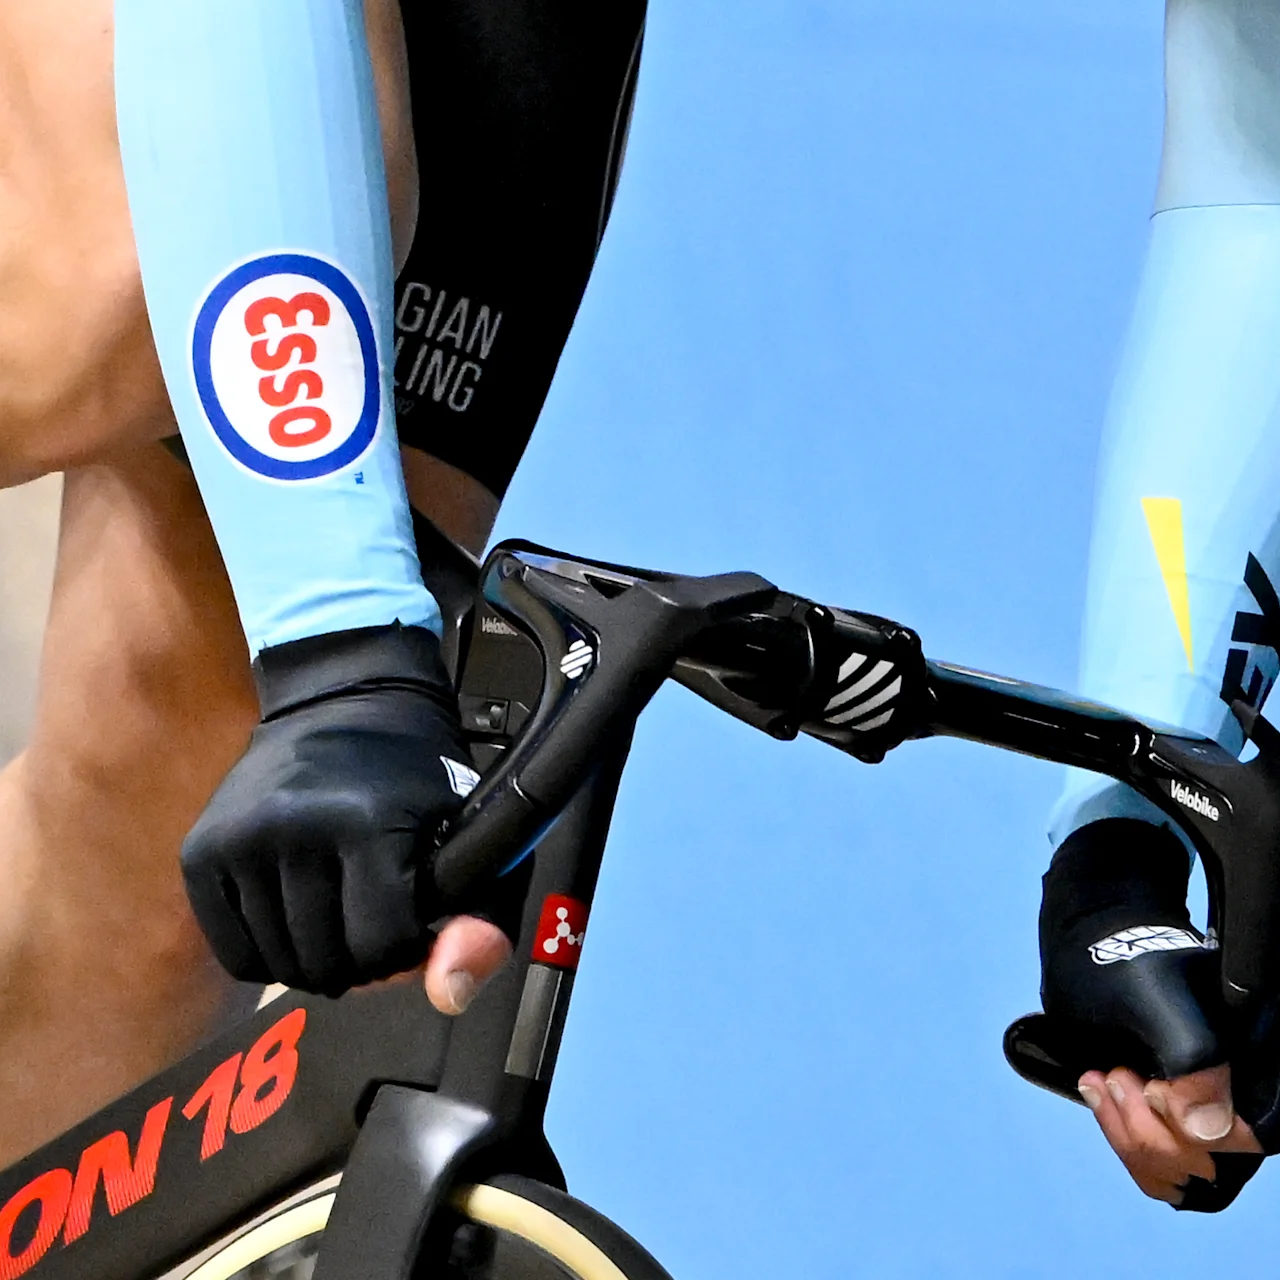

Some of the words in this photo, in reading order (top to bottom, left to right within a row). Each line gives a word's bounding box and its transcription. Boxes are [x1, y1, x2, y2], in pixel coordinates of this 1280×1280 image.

[243, 291, 332, 448] Esso
[1170, 779, 1219, 822] Velobike
[181, 1007, 307, 1163] 18
